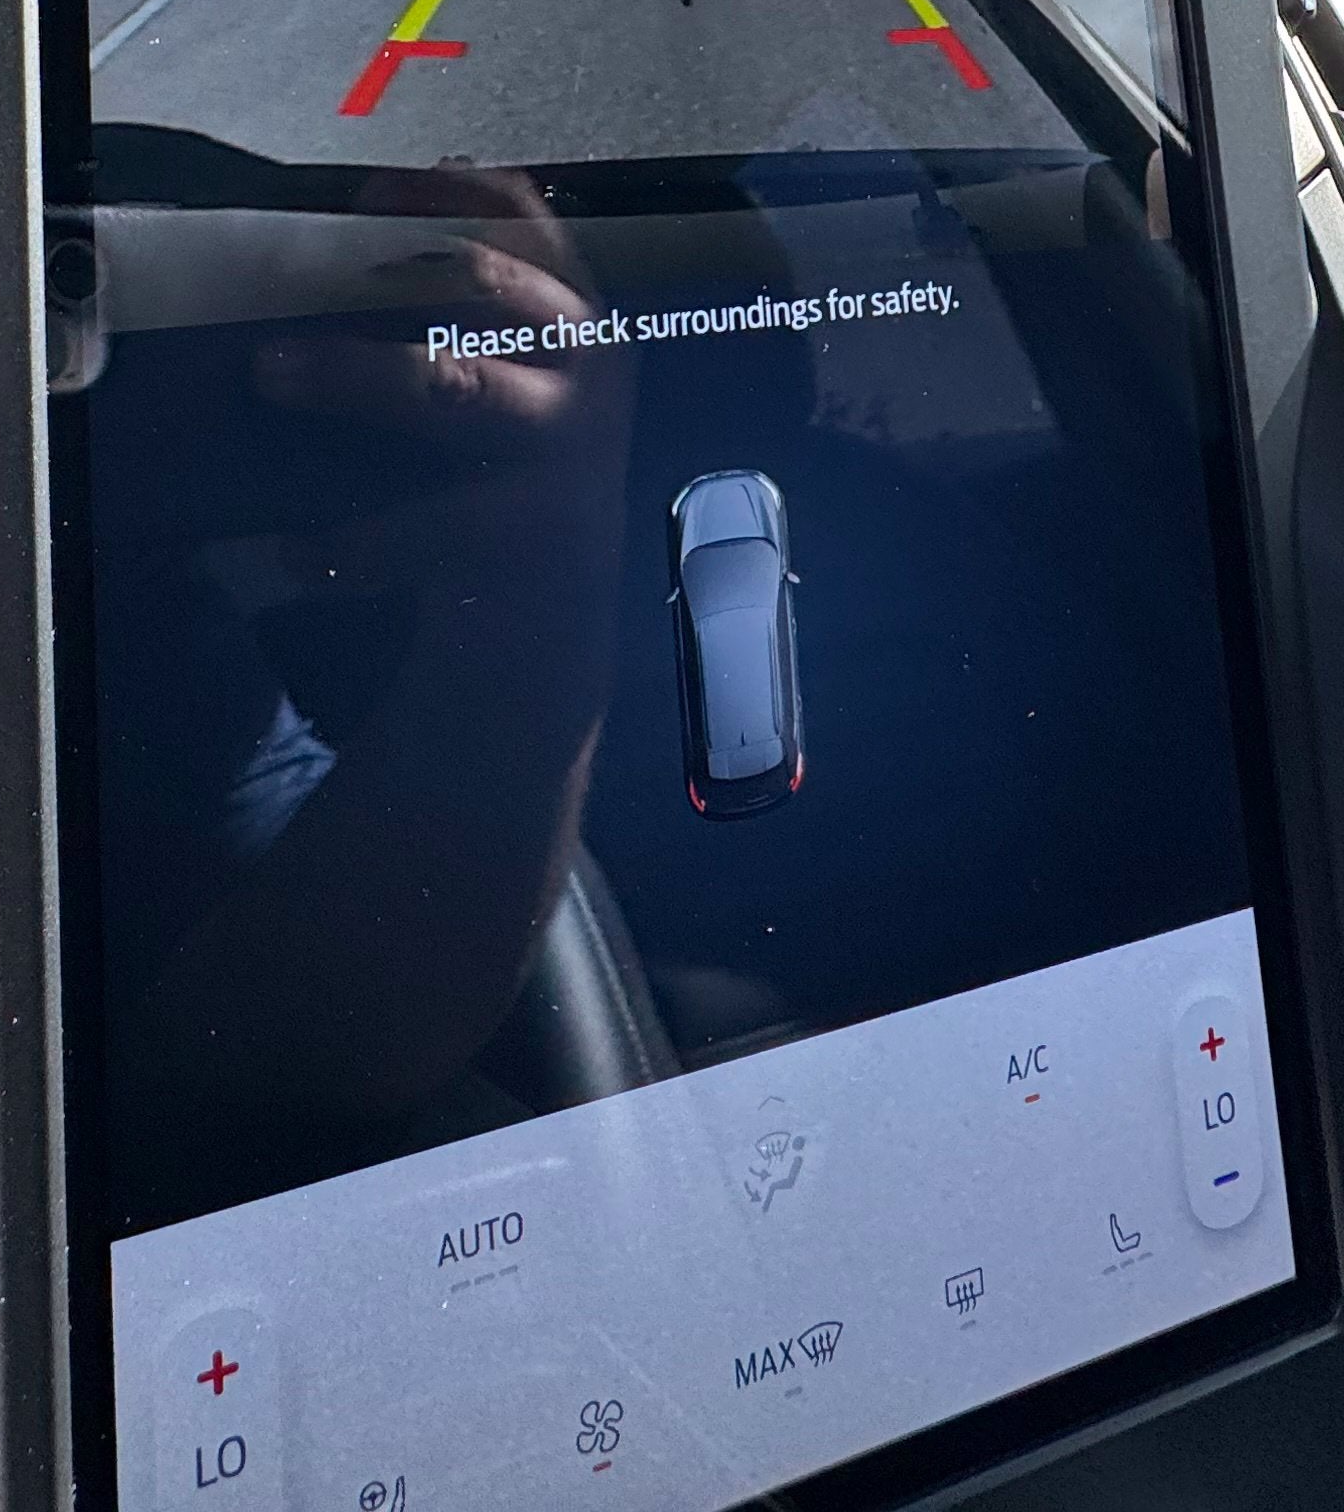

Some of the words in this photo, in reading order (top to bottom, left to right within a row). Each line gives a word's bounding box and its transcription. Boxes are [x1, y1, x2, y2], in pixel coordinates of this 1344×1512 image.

[427, 324, 535, 362] Please
[541, 312, 631, 350] check
[636, 295, 824, 341] surroundings
[825, 287, 867, 321] for
[870, 280, 961, 319] safety.
[1006, 1043, 1050, 1085] A/C
[1202, 1091, 1238, 1132] LO
[436, 1211, 525, 1269] AUTO
[734, 1337, 796, 1390] MAX
[193, 1434, 248, 1490] LO
